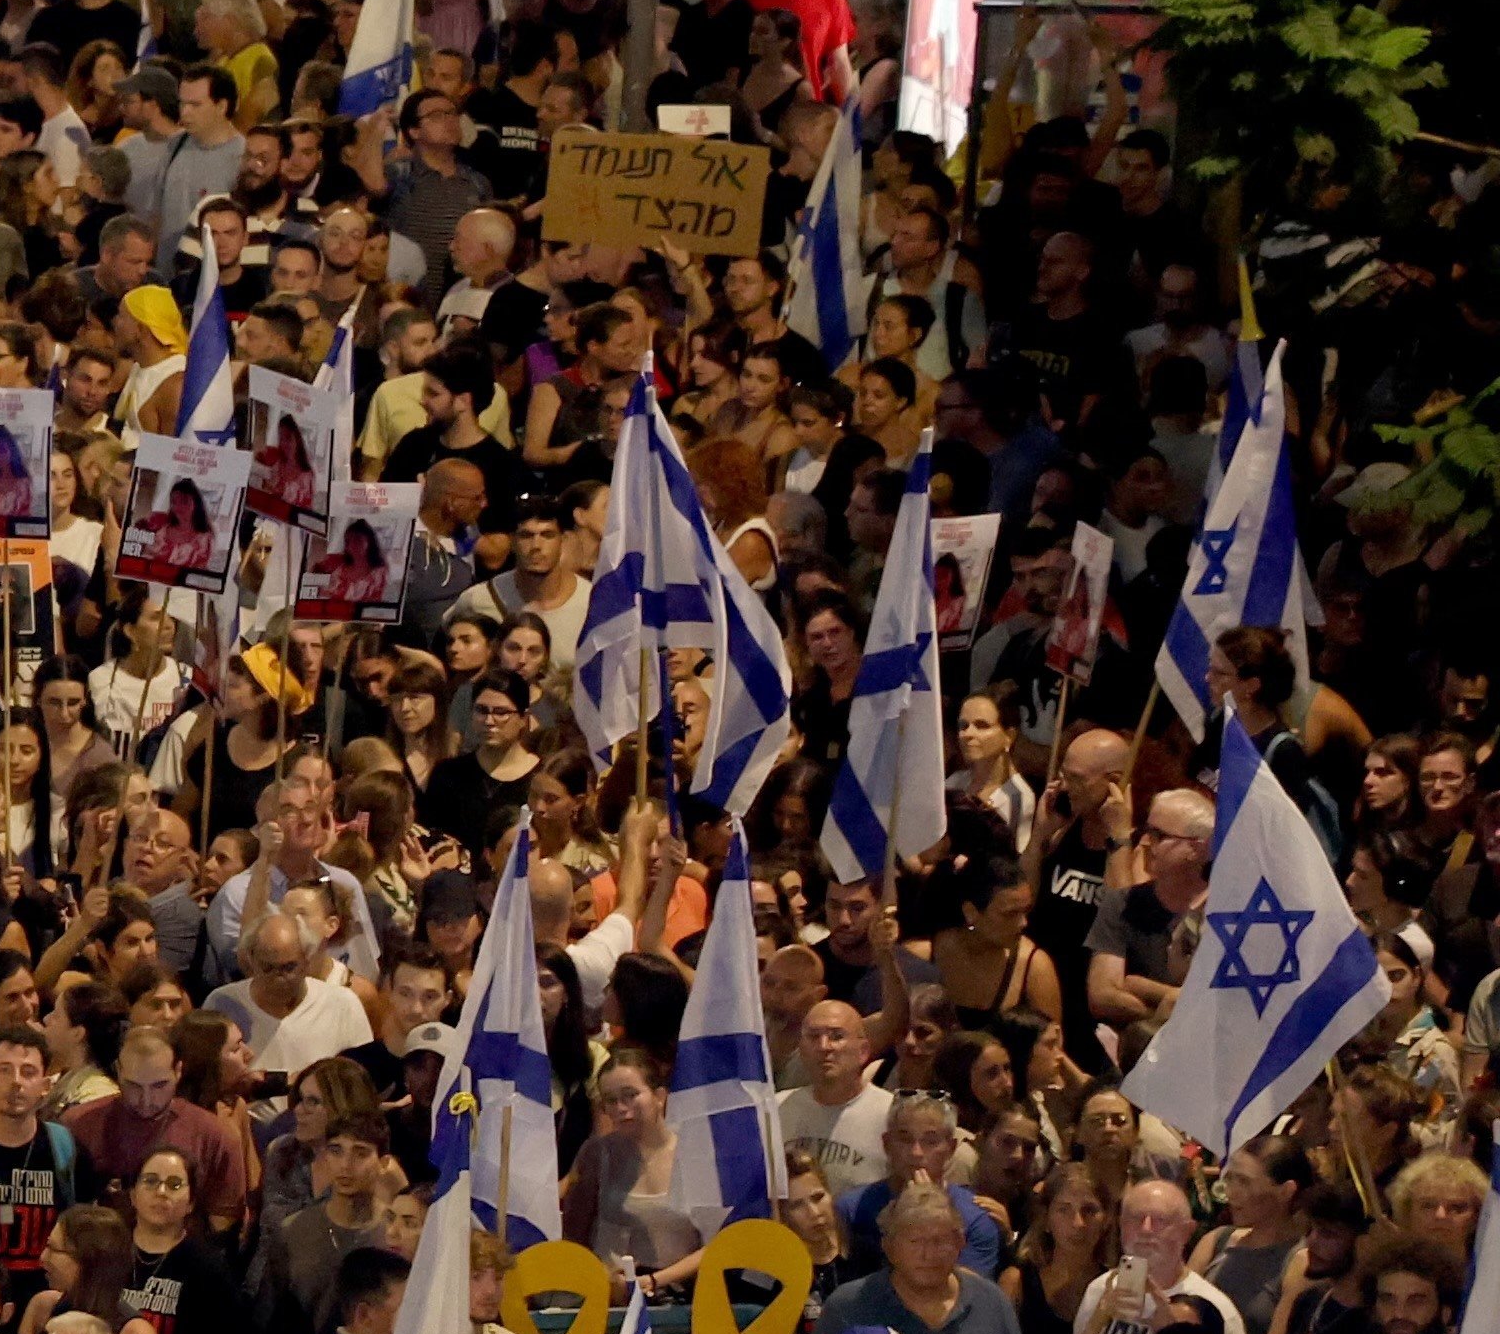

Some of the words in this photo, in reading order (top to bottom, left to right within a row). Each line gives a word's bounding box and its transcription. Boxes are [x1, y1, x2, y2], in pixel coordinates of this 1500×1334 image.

[558, 143, 672, 179] תעמדי
[690, 144, 748, 191] אל
[618, 194, 738, 237] מהצד
[11, 1169, 54, 1187] מחזירים
[25, 1186, 54, 1206] אותם
